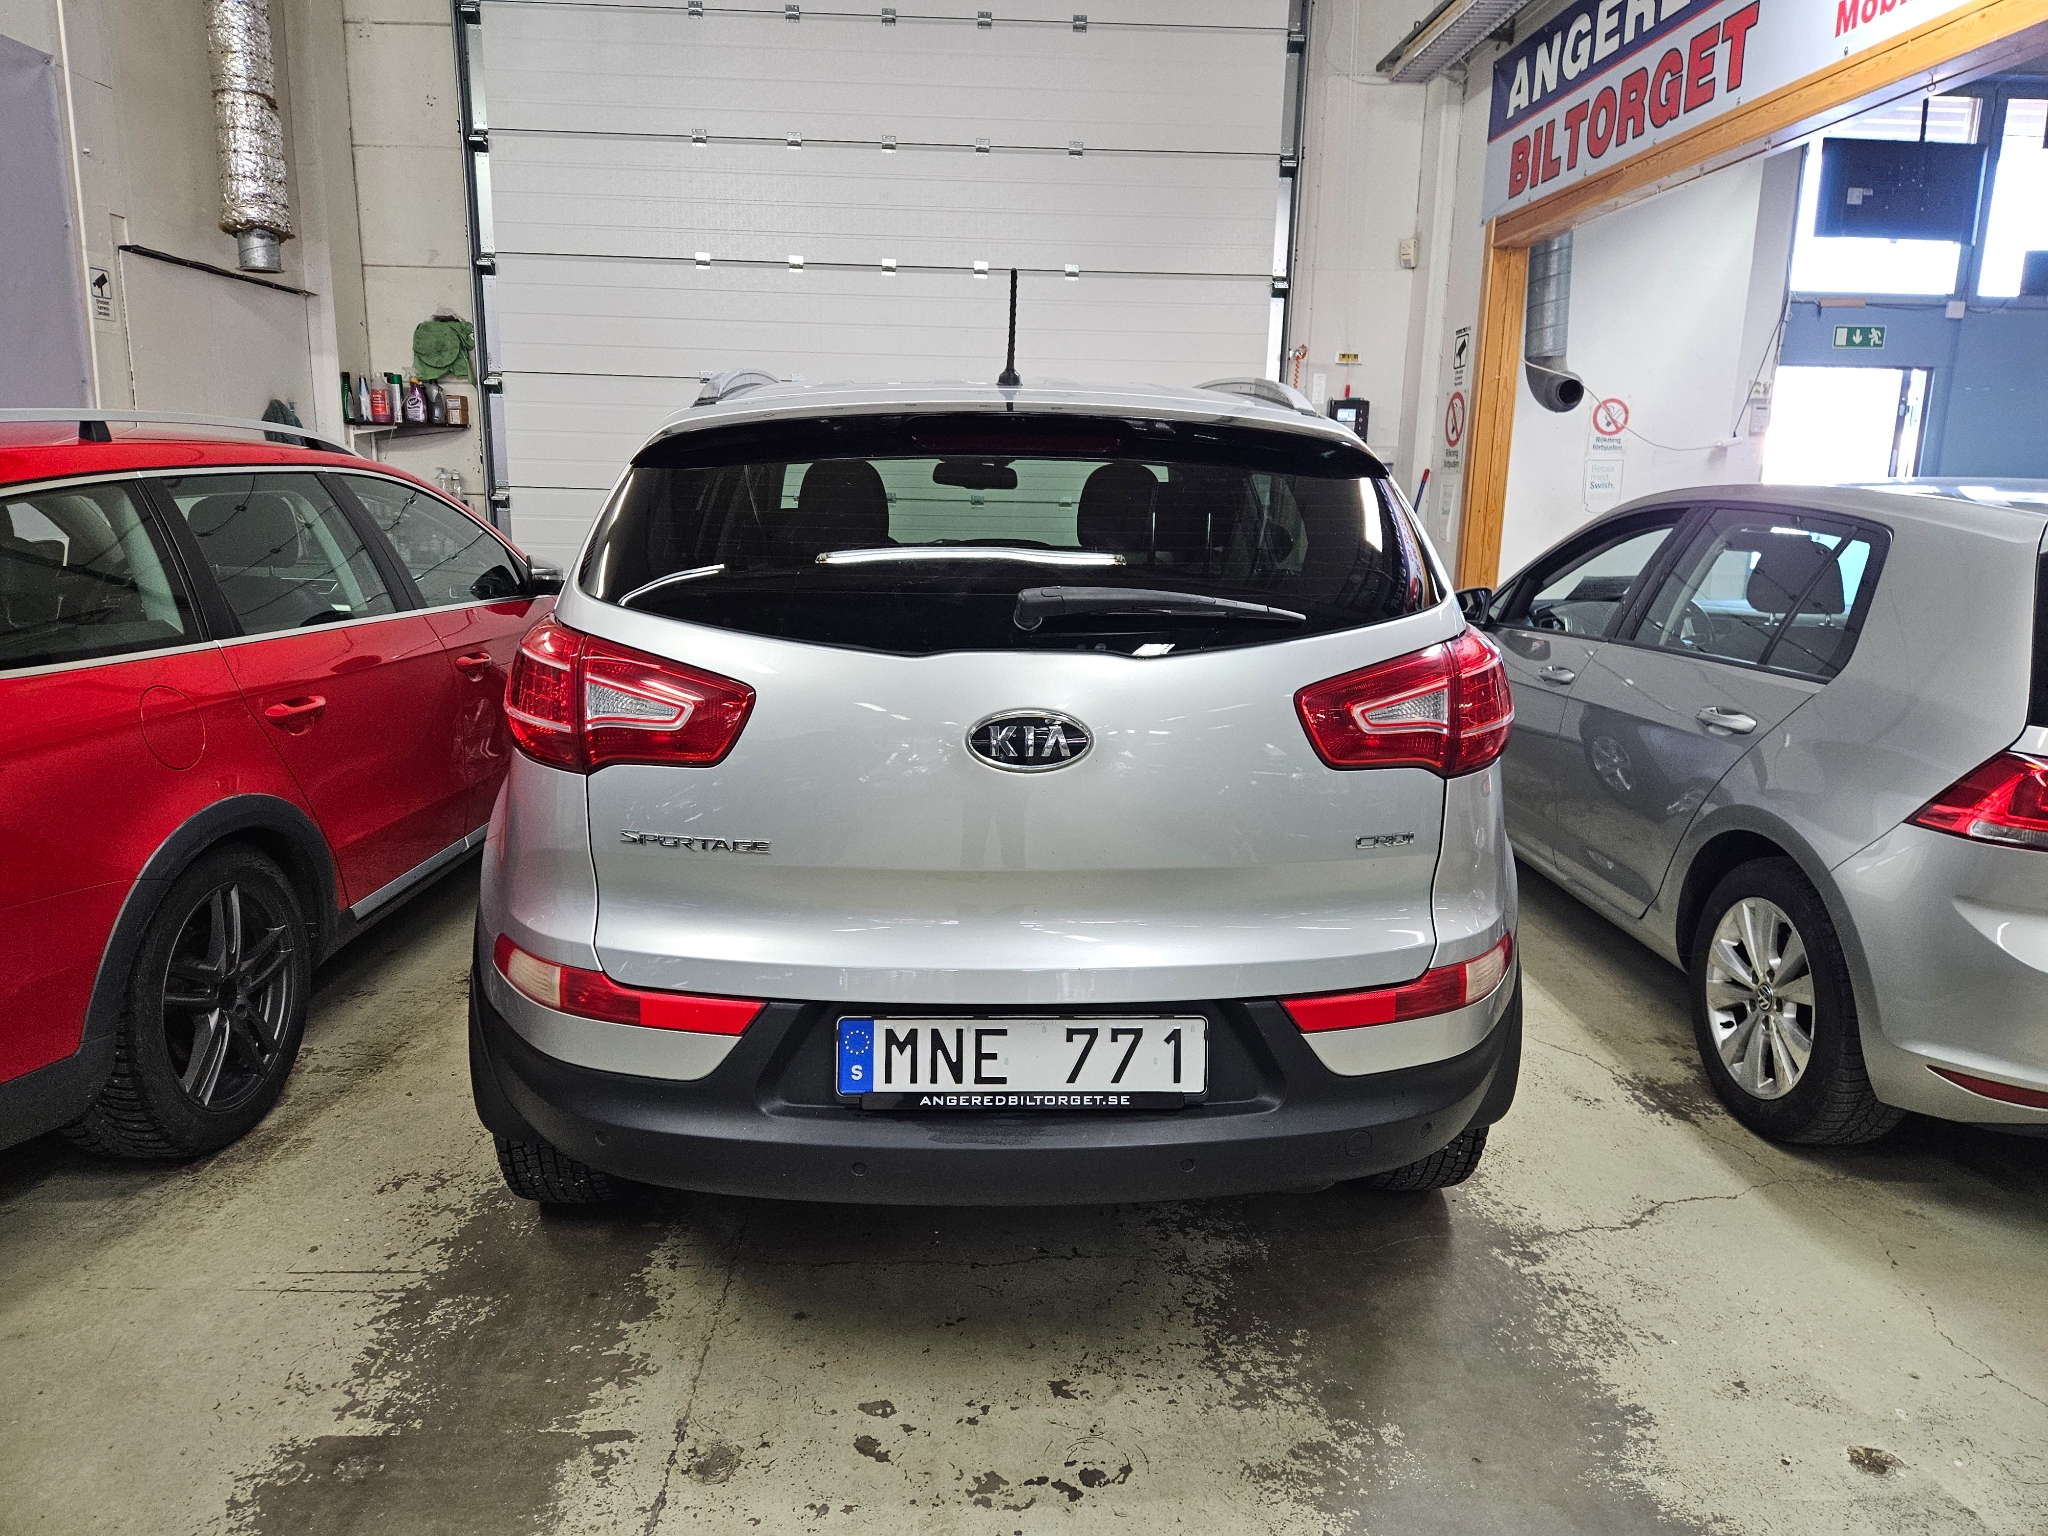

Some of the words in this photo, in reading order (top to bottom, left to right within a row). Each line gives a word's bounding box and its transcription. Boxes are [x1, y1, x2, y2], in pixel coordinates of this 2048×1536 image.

[1508, 2, 1760, 200] BILTORGET
[988, 725, 1071, 757] KIA
[620, 829, 771, 854] SPORTAGE
[885, 1028, 1008, 1085] MNE
[1066, 1027, 1182, 1084] 771
[850, 1064, 863, 1081] S
[919, 1095, 1131, 1106] ANGEREDBILTORGET.SE
